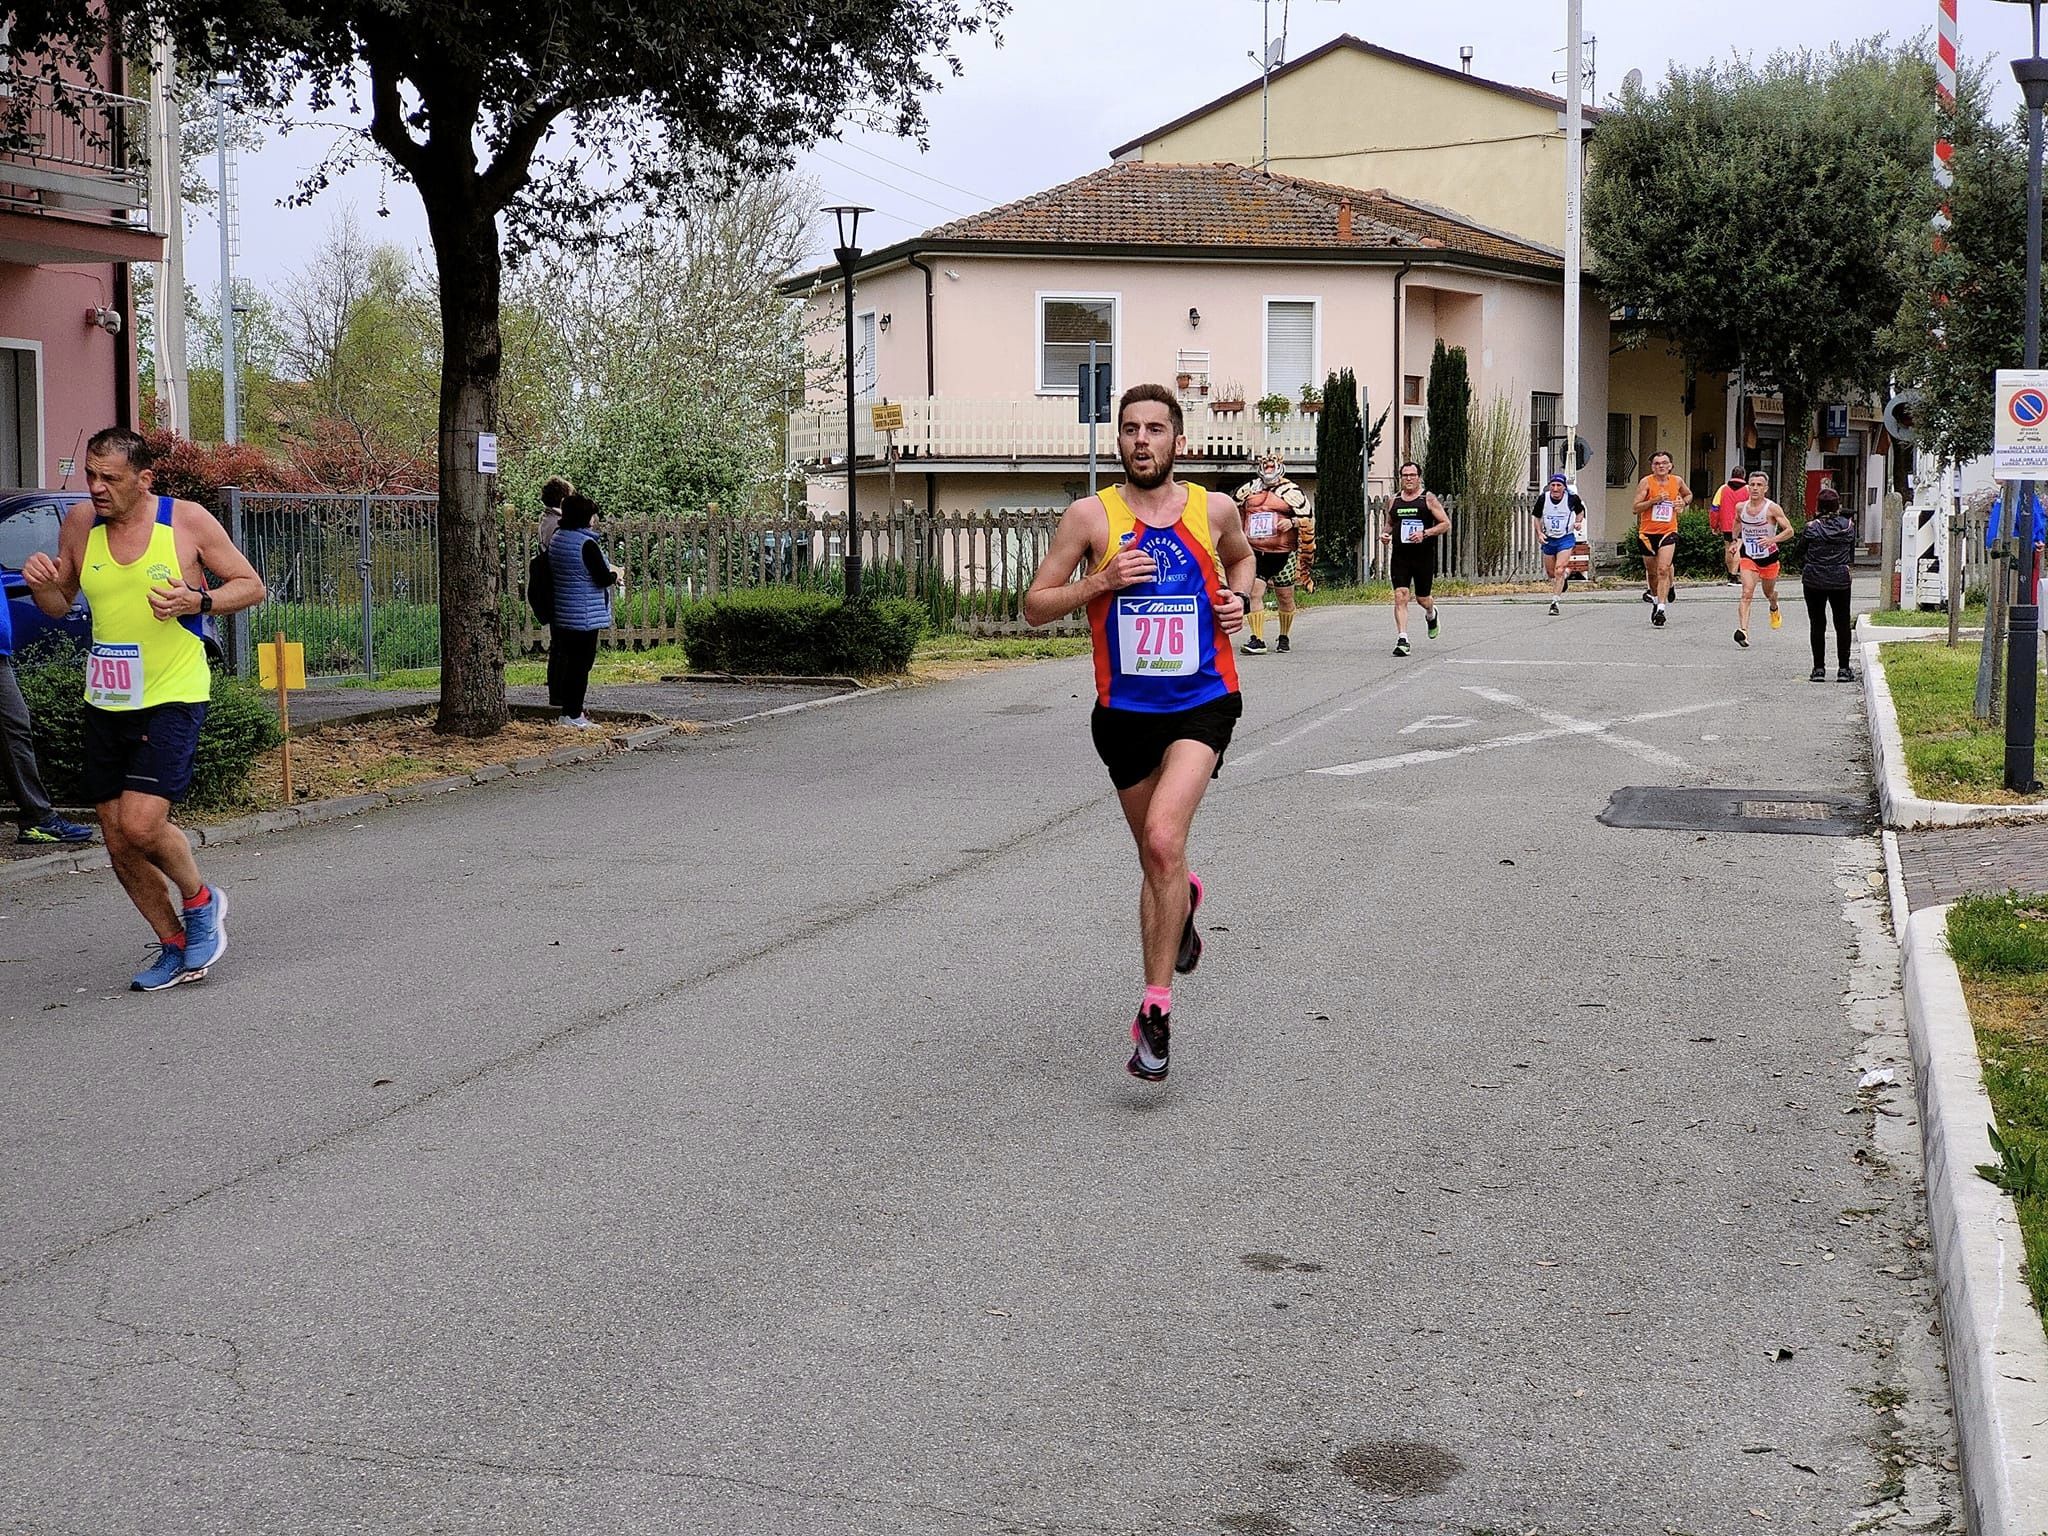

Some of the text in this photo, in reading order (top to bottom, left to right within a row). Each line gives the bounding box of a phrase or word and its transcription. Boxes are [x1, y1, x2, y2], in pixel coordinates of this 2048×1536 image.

[1552, 520, 1559, 529] 53
[1136, 617, 1183, 654] 276
[91, 657, 131, 689] 260
